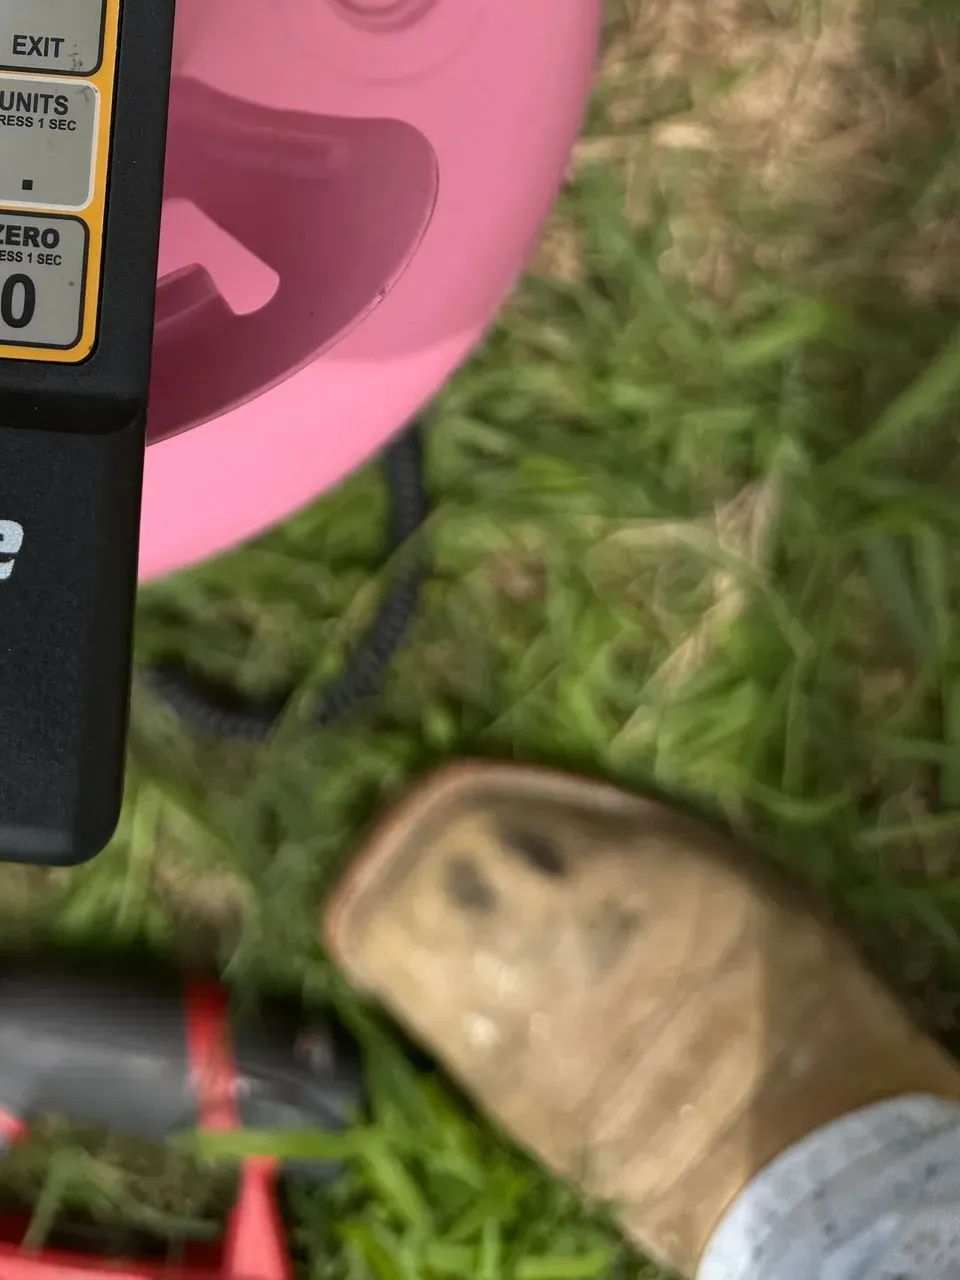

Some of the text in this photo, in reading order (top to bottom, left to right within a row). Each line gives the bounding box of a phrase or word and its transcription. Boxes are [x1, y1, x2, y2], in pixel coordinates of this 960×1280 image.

[12, 34, 65, 58] EXIT
[0, 90, 69, 115] UNITS
[48, 117, 77, 131] SEC
[36, 252, 63, 266] SEC
[0, 273, 36, 328] 0
